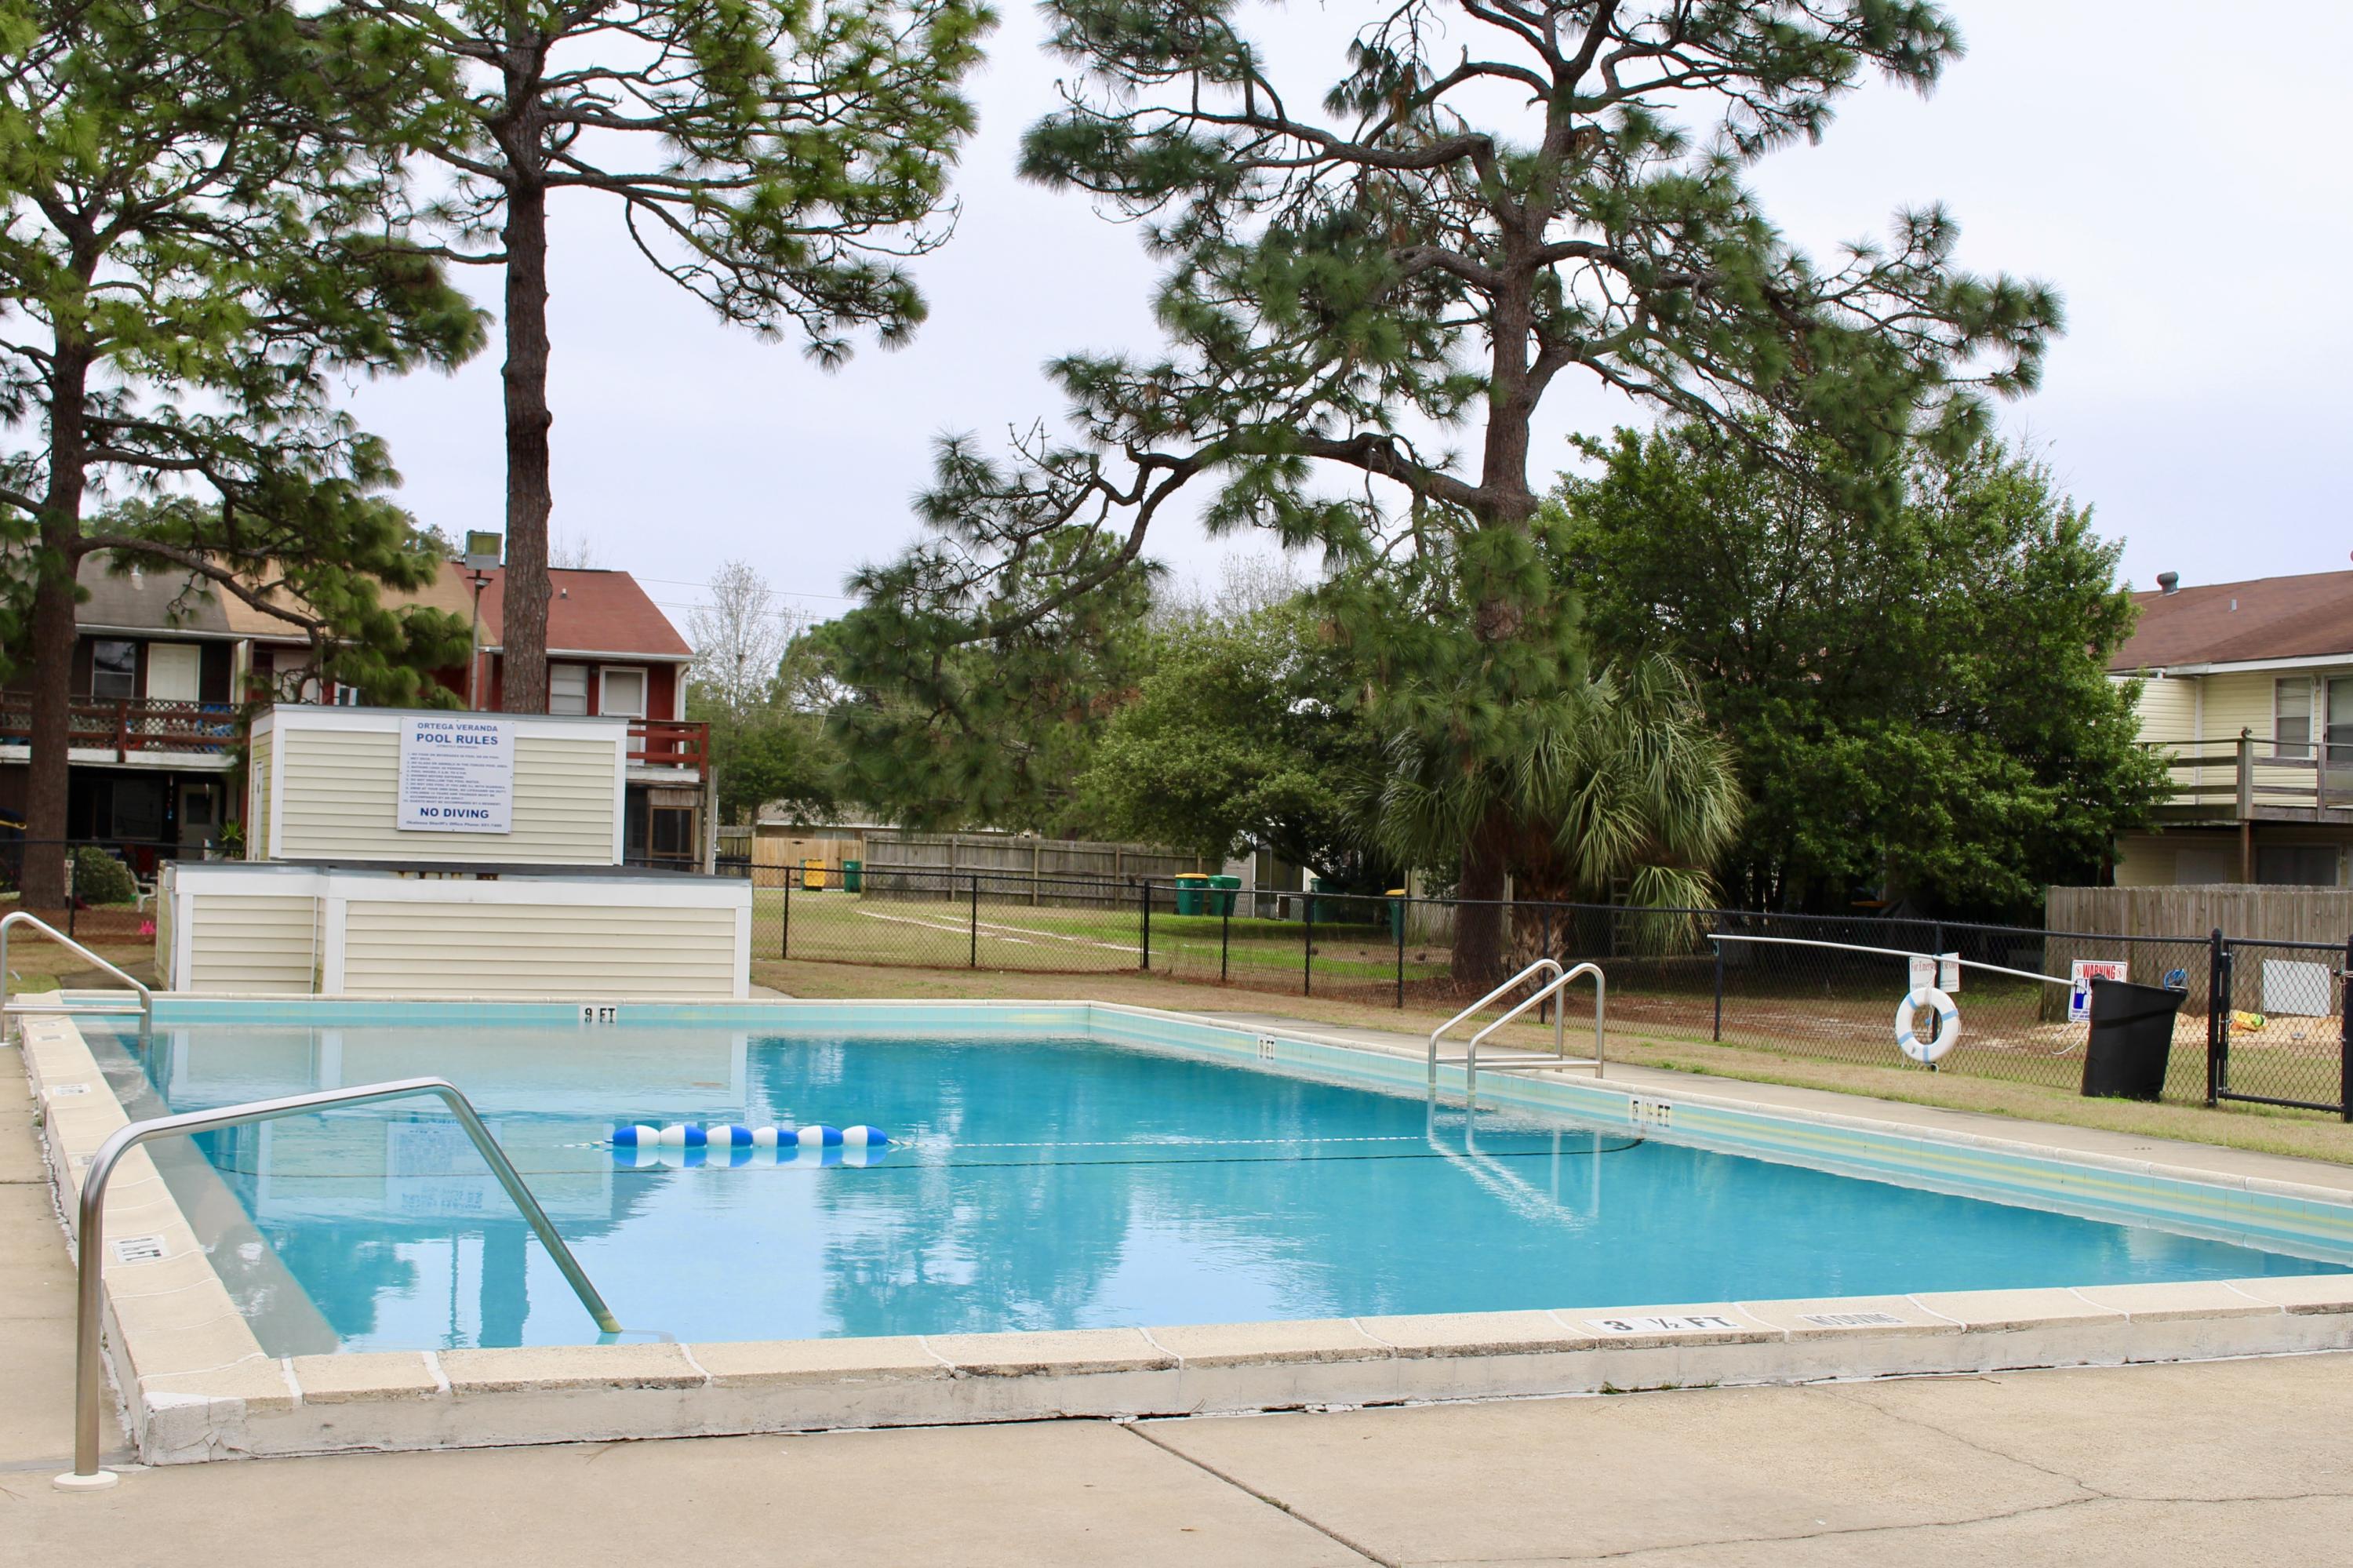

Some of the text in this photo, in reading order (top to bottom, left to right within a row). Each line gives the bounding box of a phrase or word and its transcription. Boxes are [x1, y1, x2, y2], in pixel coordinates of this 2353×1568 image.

[416, 733, 498, 745] POOL RULES
[420, 807, 489, 819] NO DIVING
[2083, 964, 2115, 979] WARNING
[585, 1007, 616, 1018] 9 FT
[1658, 1104, 1671, 1117] FT
[1603, 1320, 1634, 1331] 3
